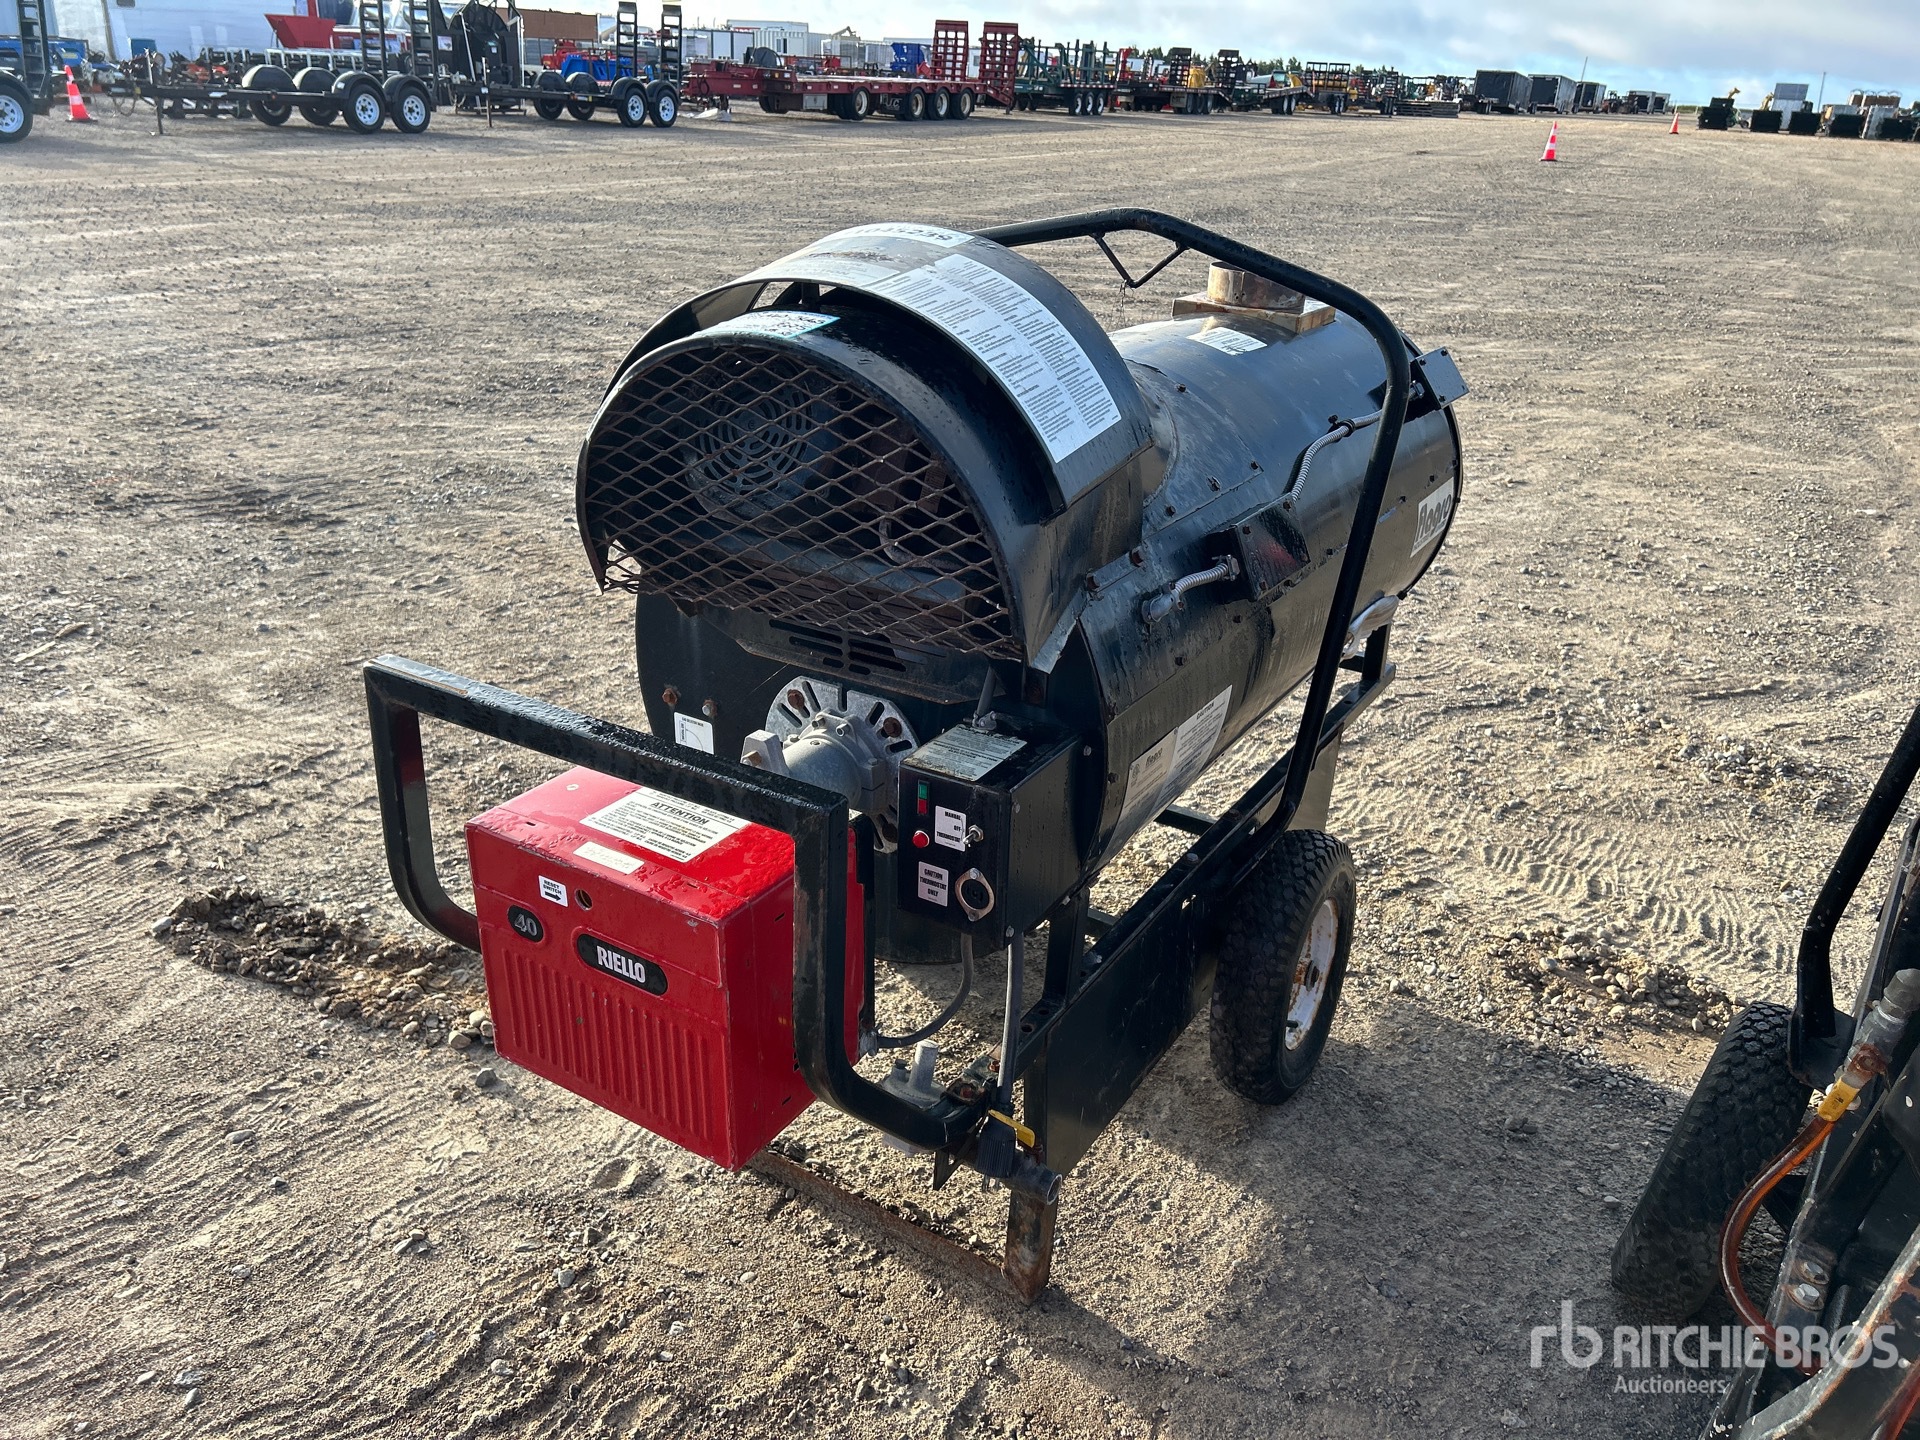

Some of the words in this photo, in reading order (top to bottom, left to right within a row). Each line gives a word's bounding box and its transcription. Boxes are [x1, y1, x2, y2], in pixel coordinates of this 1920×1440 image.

[651, 802, 710, 825] ATTENTION
[944, 811, 961, 821] MANUAL
[936, 831, 961, 843] THERMOSTAT
[924, 868, 943, 880] CAUTION
[543, 879, 560, 890] RESET
[920, 876, 947, 891] THERMOSTAT
[543, 884, 562, 896] SWITCH
[927, 888, 939, 897] ONLY
[514, 913, 538, 937] 40
[596, 945, 646, 984] RIELLO
